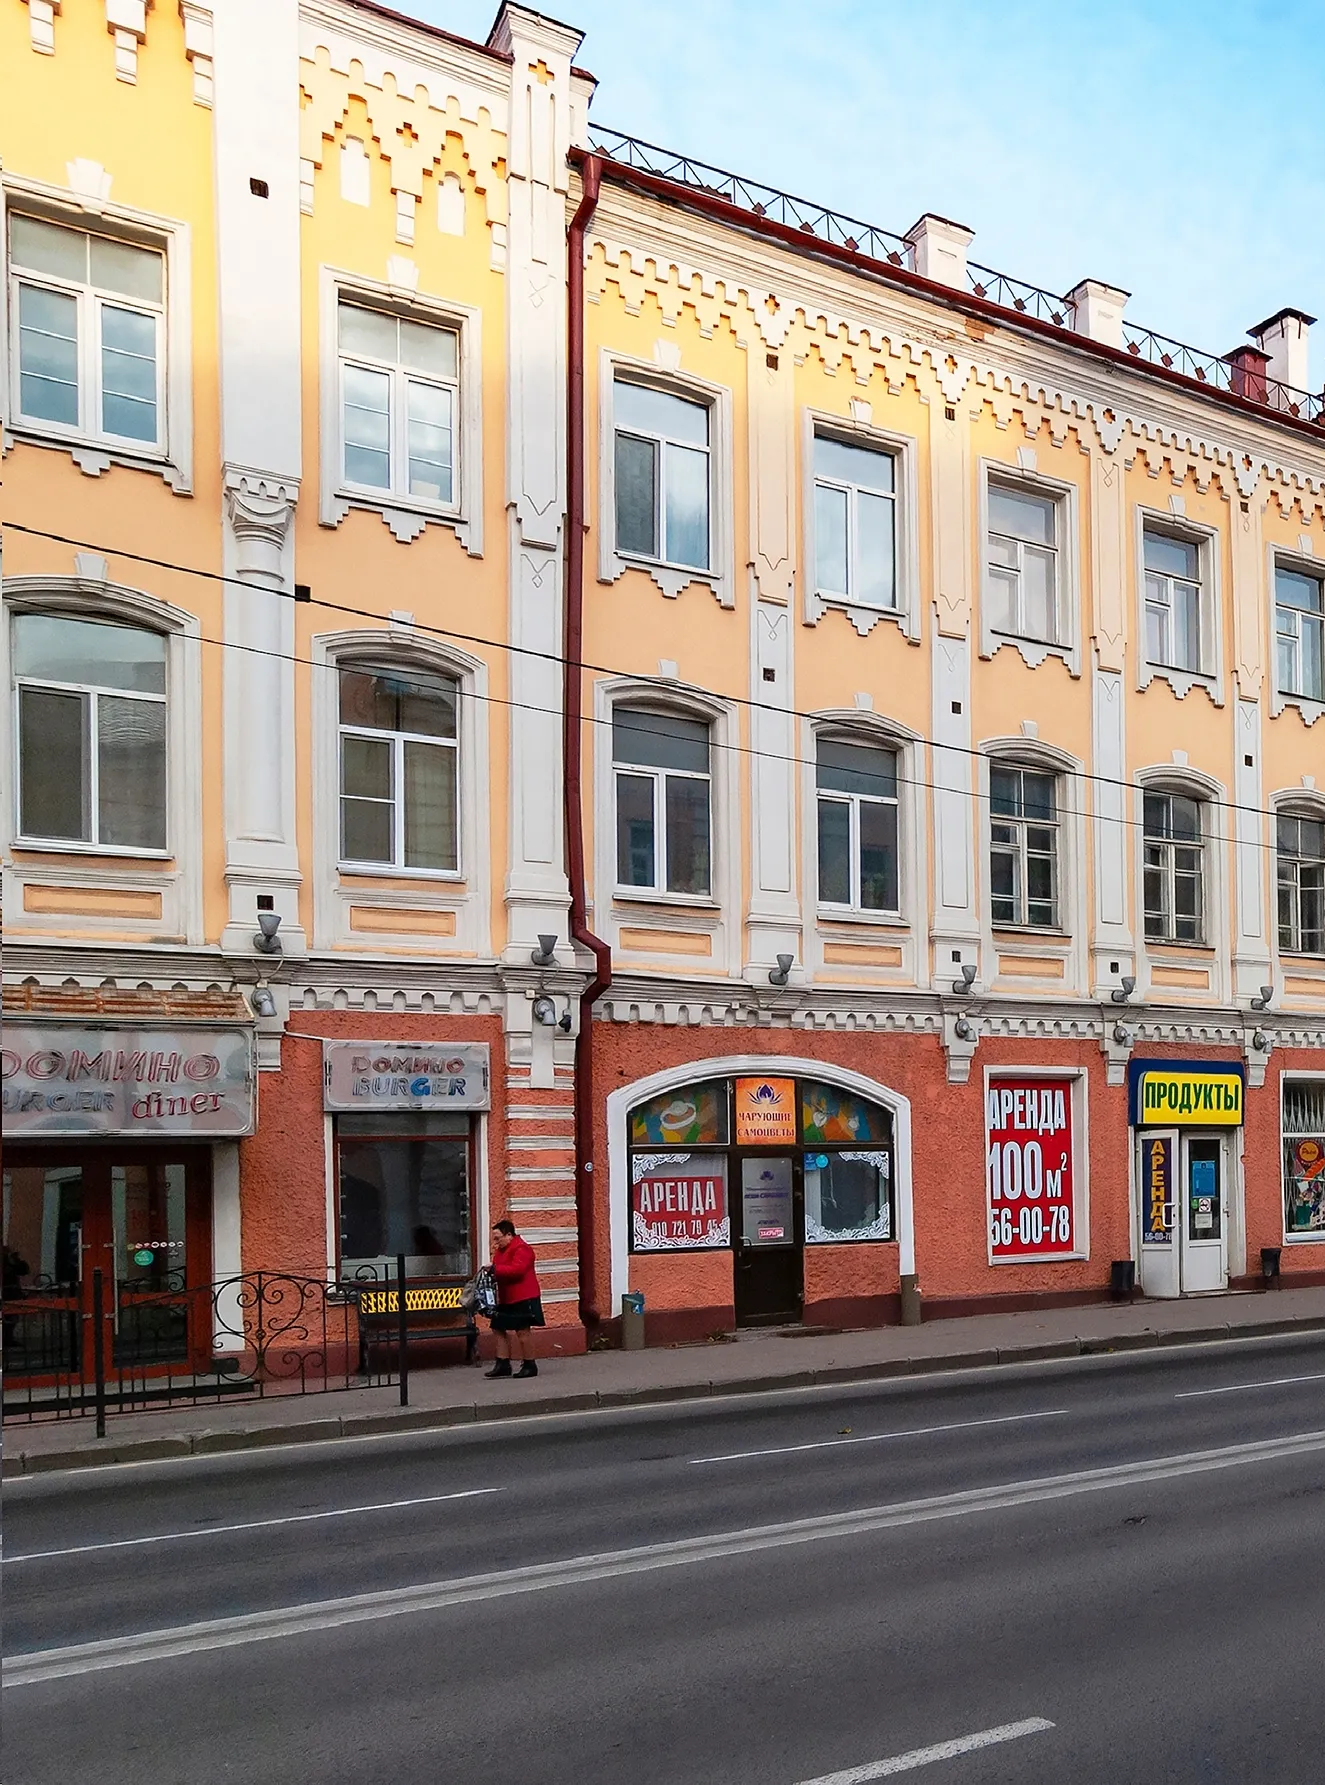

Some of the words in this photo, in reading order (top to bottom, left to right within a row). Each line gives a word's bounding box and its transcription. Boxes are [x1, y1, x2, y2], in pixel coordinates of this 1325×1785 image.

[353, 1077, 467, 1096] BURGER
[1145, 1082, 1239, 1114] ПРОДУКТЫ
[132, 1090, 226, 1119] diner
[989, 1089, 1066, 1136] АРЕНДА
[738, 1128, 794, 1137] САМОЦВЕТЫ
[989, 1141, 1043, 1200] 100
[1150, 1140, 1166, 1232] АРЕНДА
[640, 1181, 717, 1215] АРЕНДА
[672, 1221, 687, 1236] 721
[691, 1219, 702, 1235] 79
[991, 1205, 1070, 1246] 56-00-78
[1144, 1232, 1172, 1241] 56-00-7
